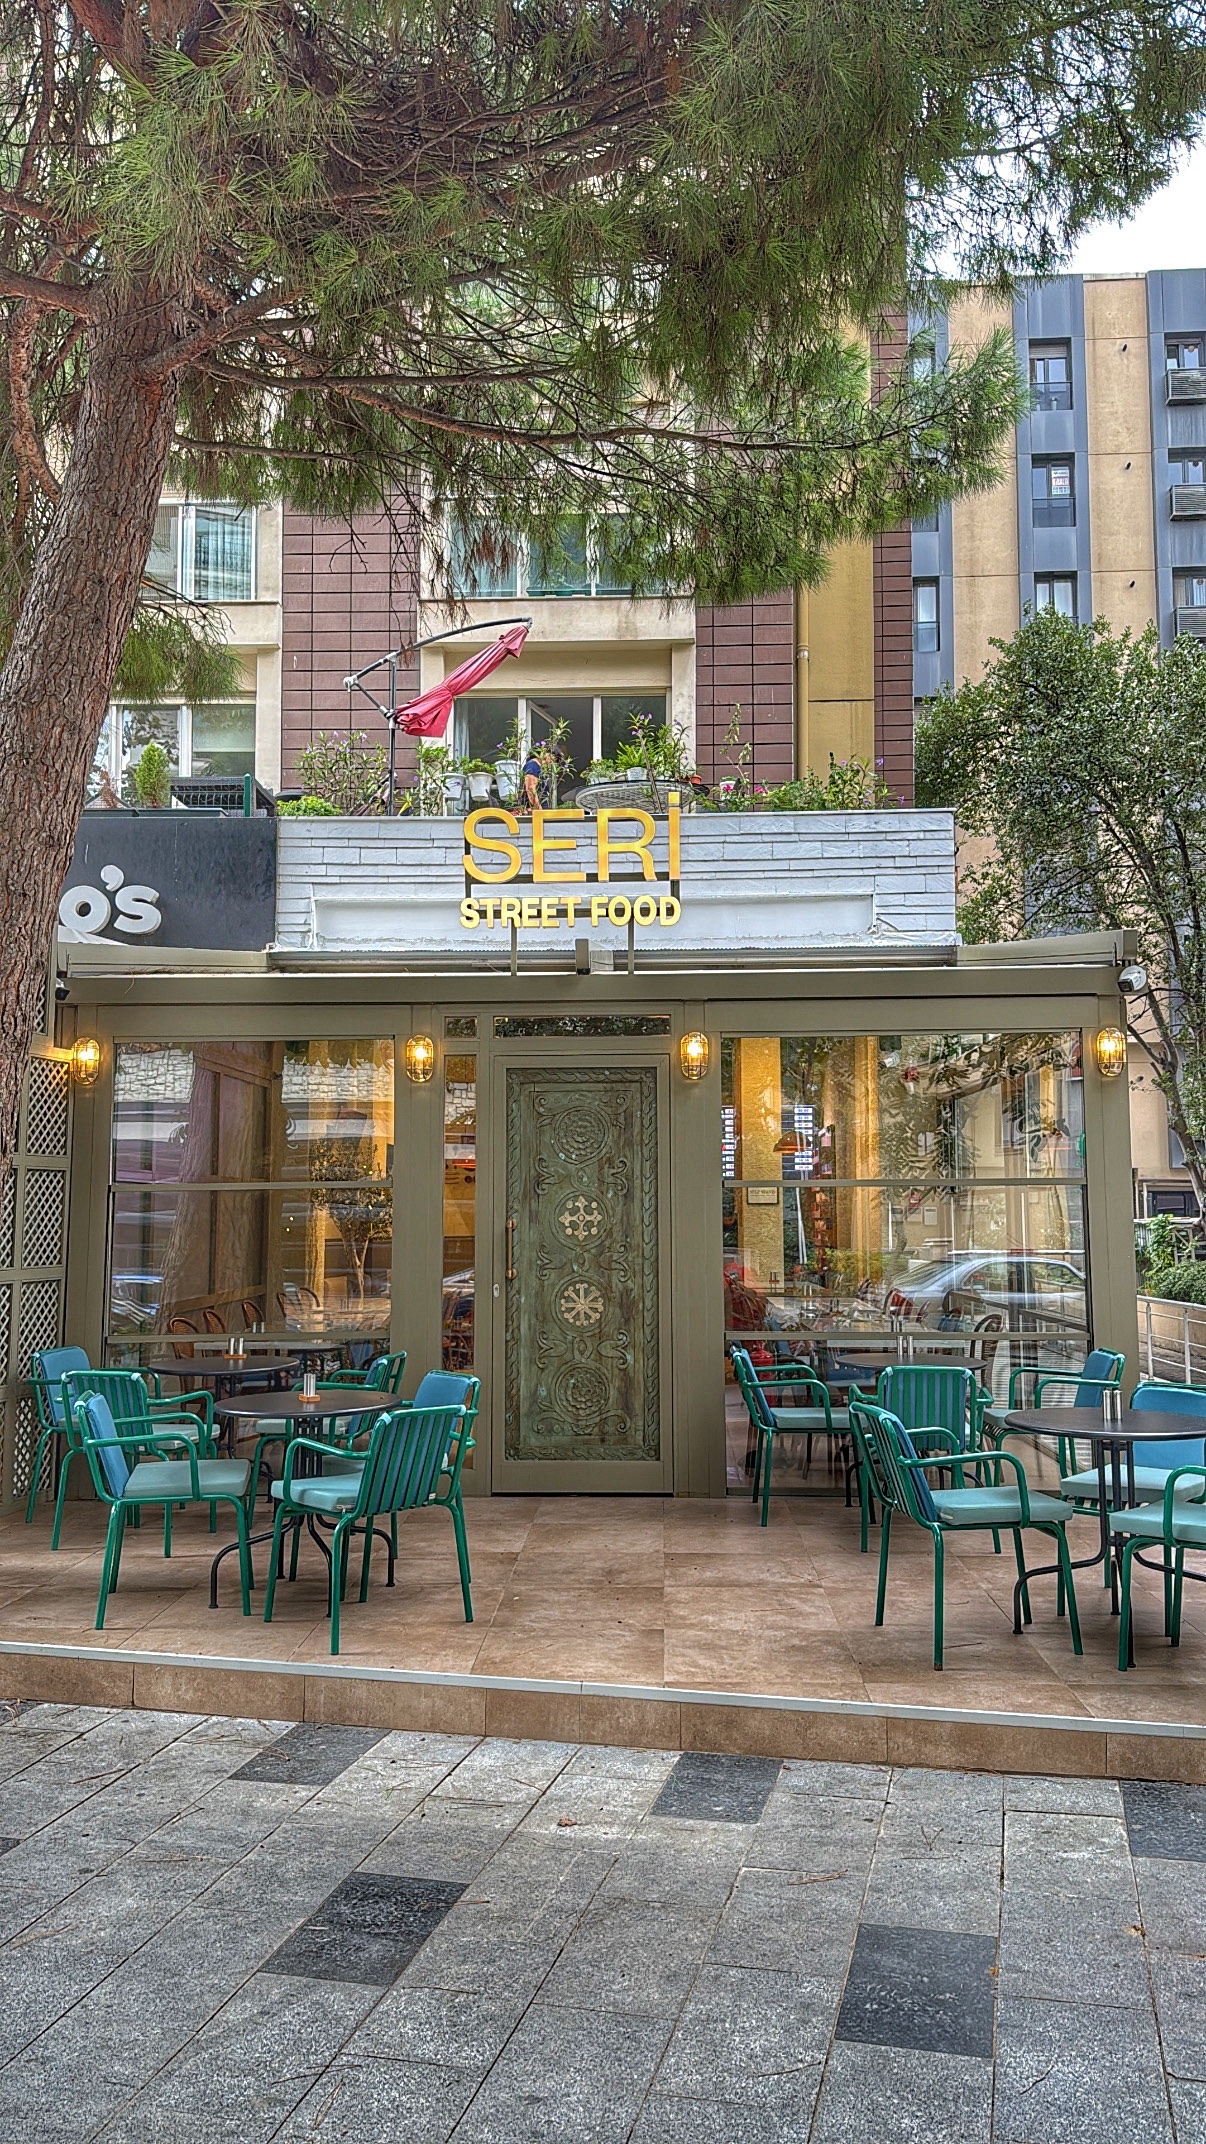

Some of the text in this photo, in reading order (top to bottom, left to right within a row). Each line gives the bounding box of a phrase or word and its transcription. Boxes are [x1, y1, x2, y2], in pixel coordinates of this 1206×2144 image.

[462, 791, 681, 883] SERİ
[460, 895, 681, 929] STREET FOOD
